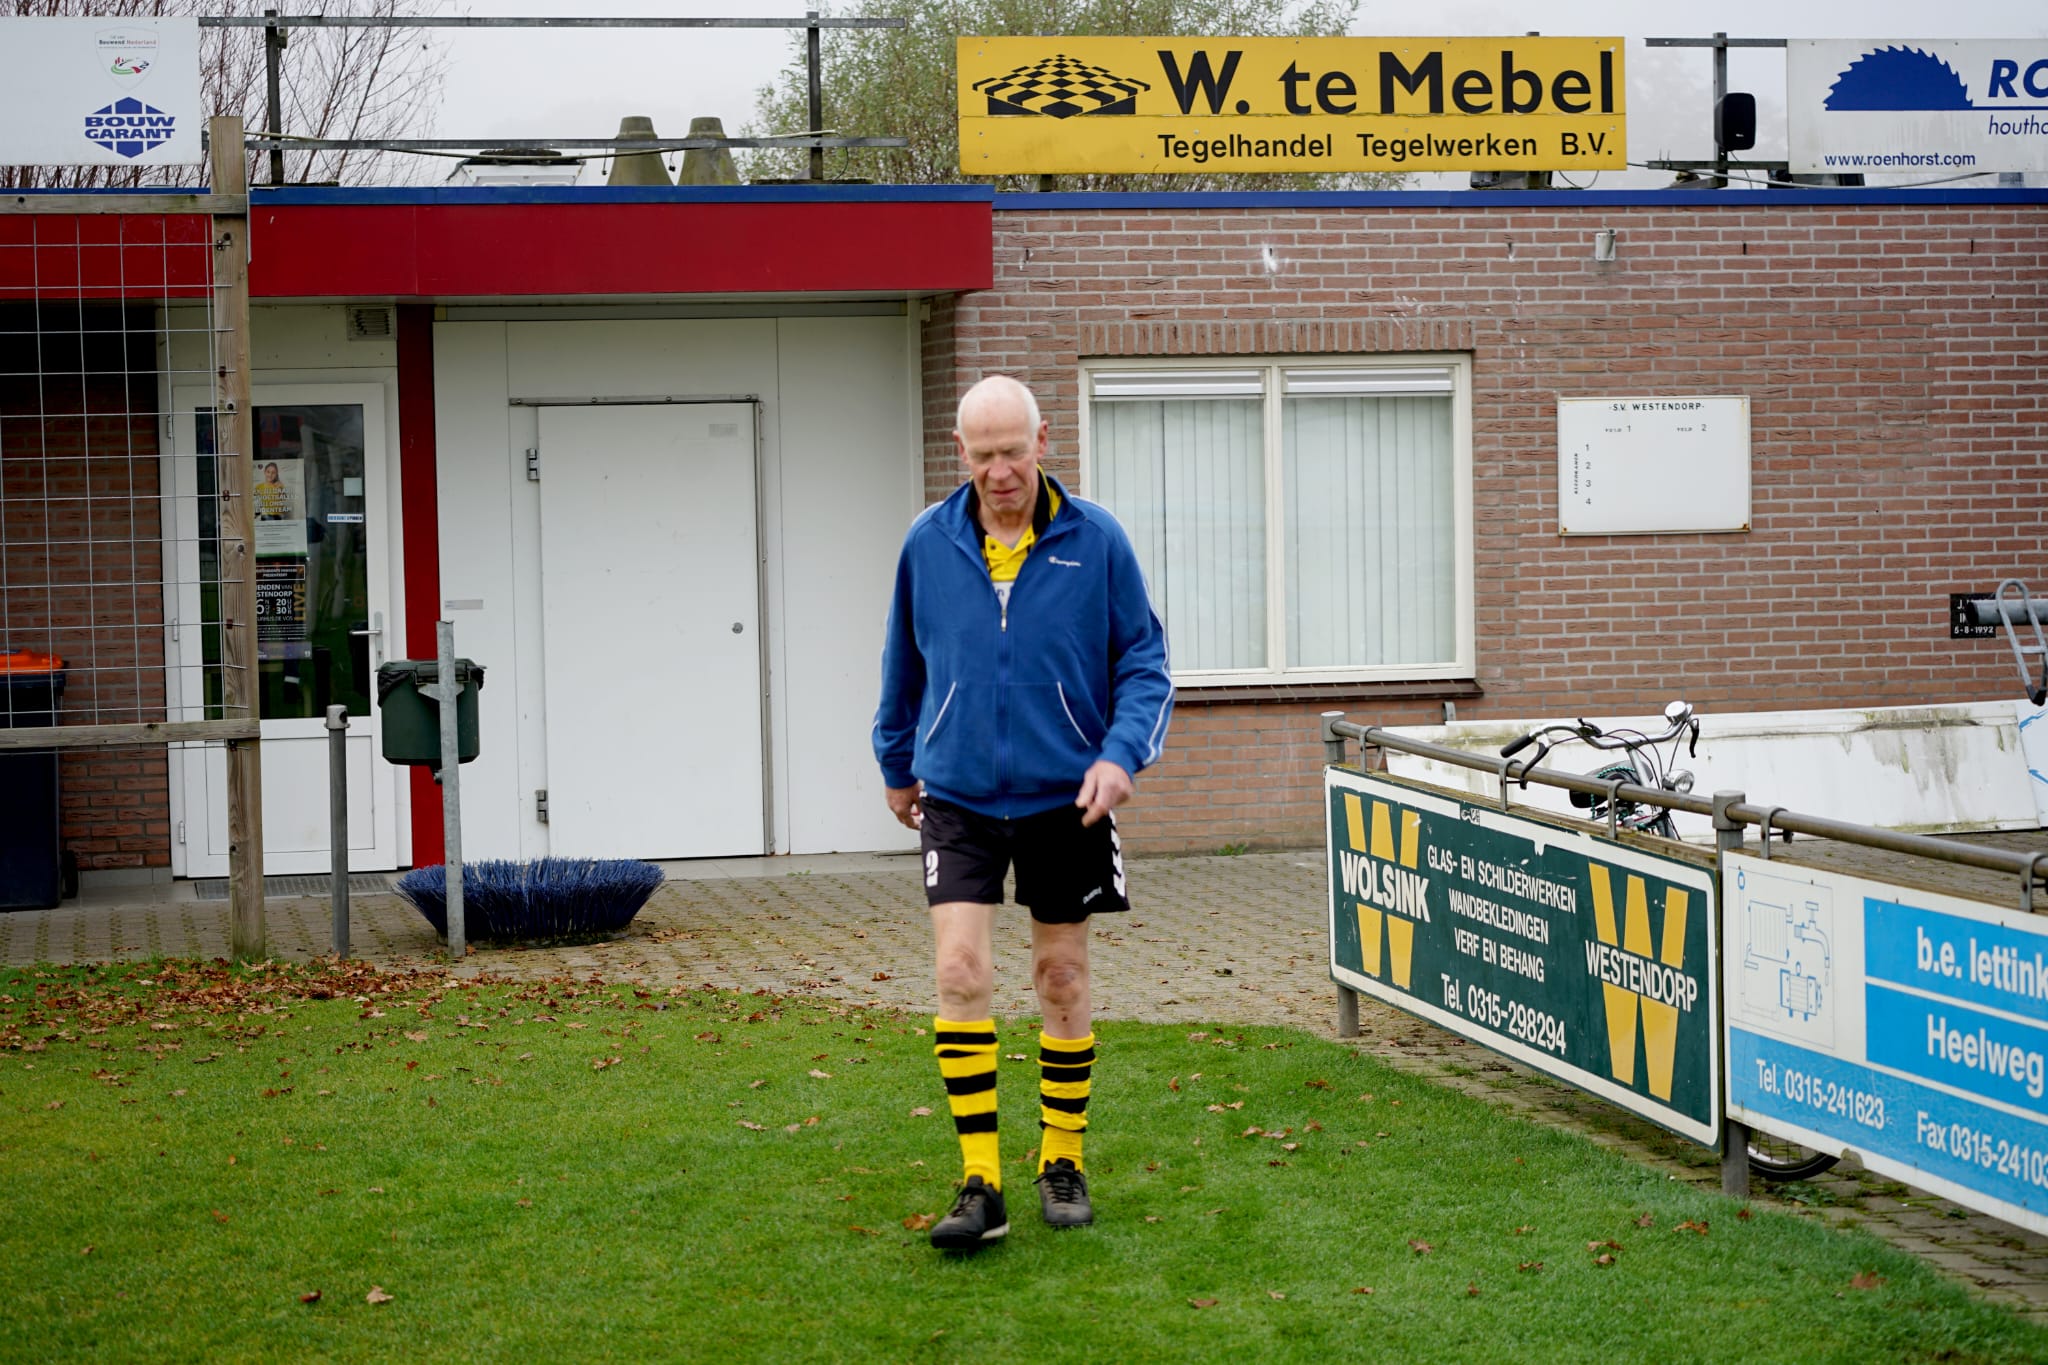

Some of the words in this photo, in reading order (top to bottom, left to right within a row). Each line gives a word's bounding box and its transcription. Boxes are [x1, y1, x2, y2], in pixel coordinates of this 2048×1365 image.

[1157, 50, 1250, 114] W.
[1278, 60, 1357, 114] te
[1379, 50, 1614, 114] Mebel
[84, 128, 176, 138] GARANT
[85, 116, 176, 127] BOUW
[1157, 133, 1332, 163] Tegelhandel
[1356, 133, 1537, 162] Tegelwerken
[1561, 132, 1612, 155] B.V.
[1824, 152, 1976, 166] www.roenhorst.com
[1701, 424, 1706, 432] 2
[1586, 462, 1591, 470] 2
[1586, 480, 1592, 488] 3
[294, 584, 305, 621] LIVE
[926, 850, 938, 887] 2
[1339, 850, 1430, 923] WOLSINK
[1428, 845, 1458, 874] GLAS-
[1461, 855, 1474, 882] EN
[1478, 857, 1576, 914] SCHILDERWERKEN
[1448, 888, 1548, 944] WANDBEKLEDINGEN
[1454, 928, 1479, 956] VERF
[1482, 937, 1497, 965] EN
[1500, 944, 1544, 982] BEHANG
[1585, 940, 1698, 1012] WESTENDORP
[1917, 926, 1962, 978] b.e.
[1970, 938, 2048, 1000] lettink
[1441, 973, 1463, 1012] Tel.
[1468, 984, 1567, 1055] 0315-298294
[1928, 1014, 2044, 1098] Heelweg
[1756, 1058, 1780, 1094] Tel.
[1785, 1069, 1885, 1130] 0315-241623
[1917, 1110, 1947, 1152] Fax
